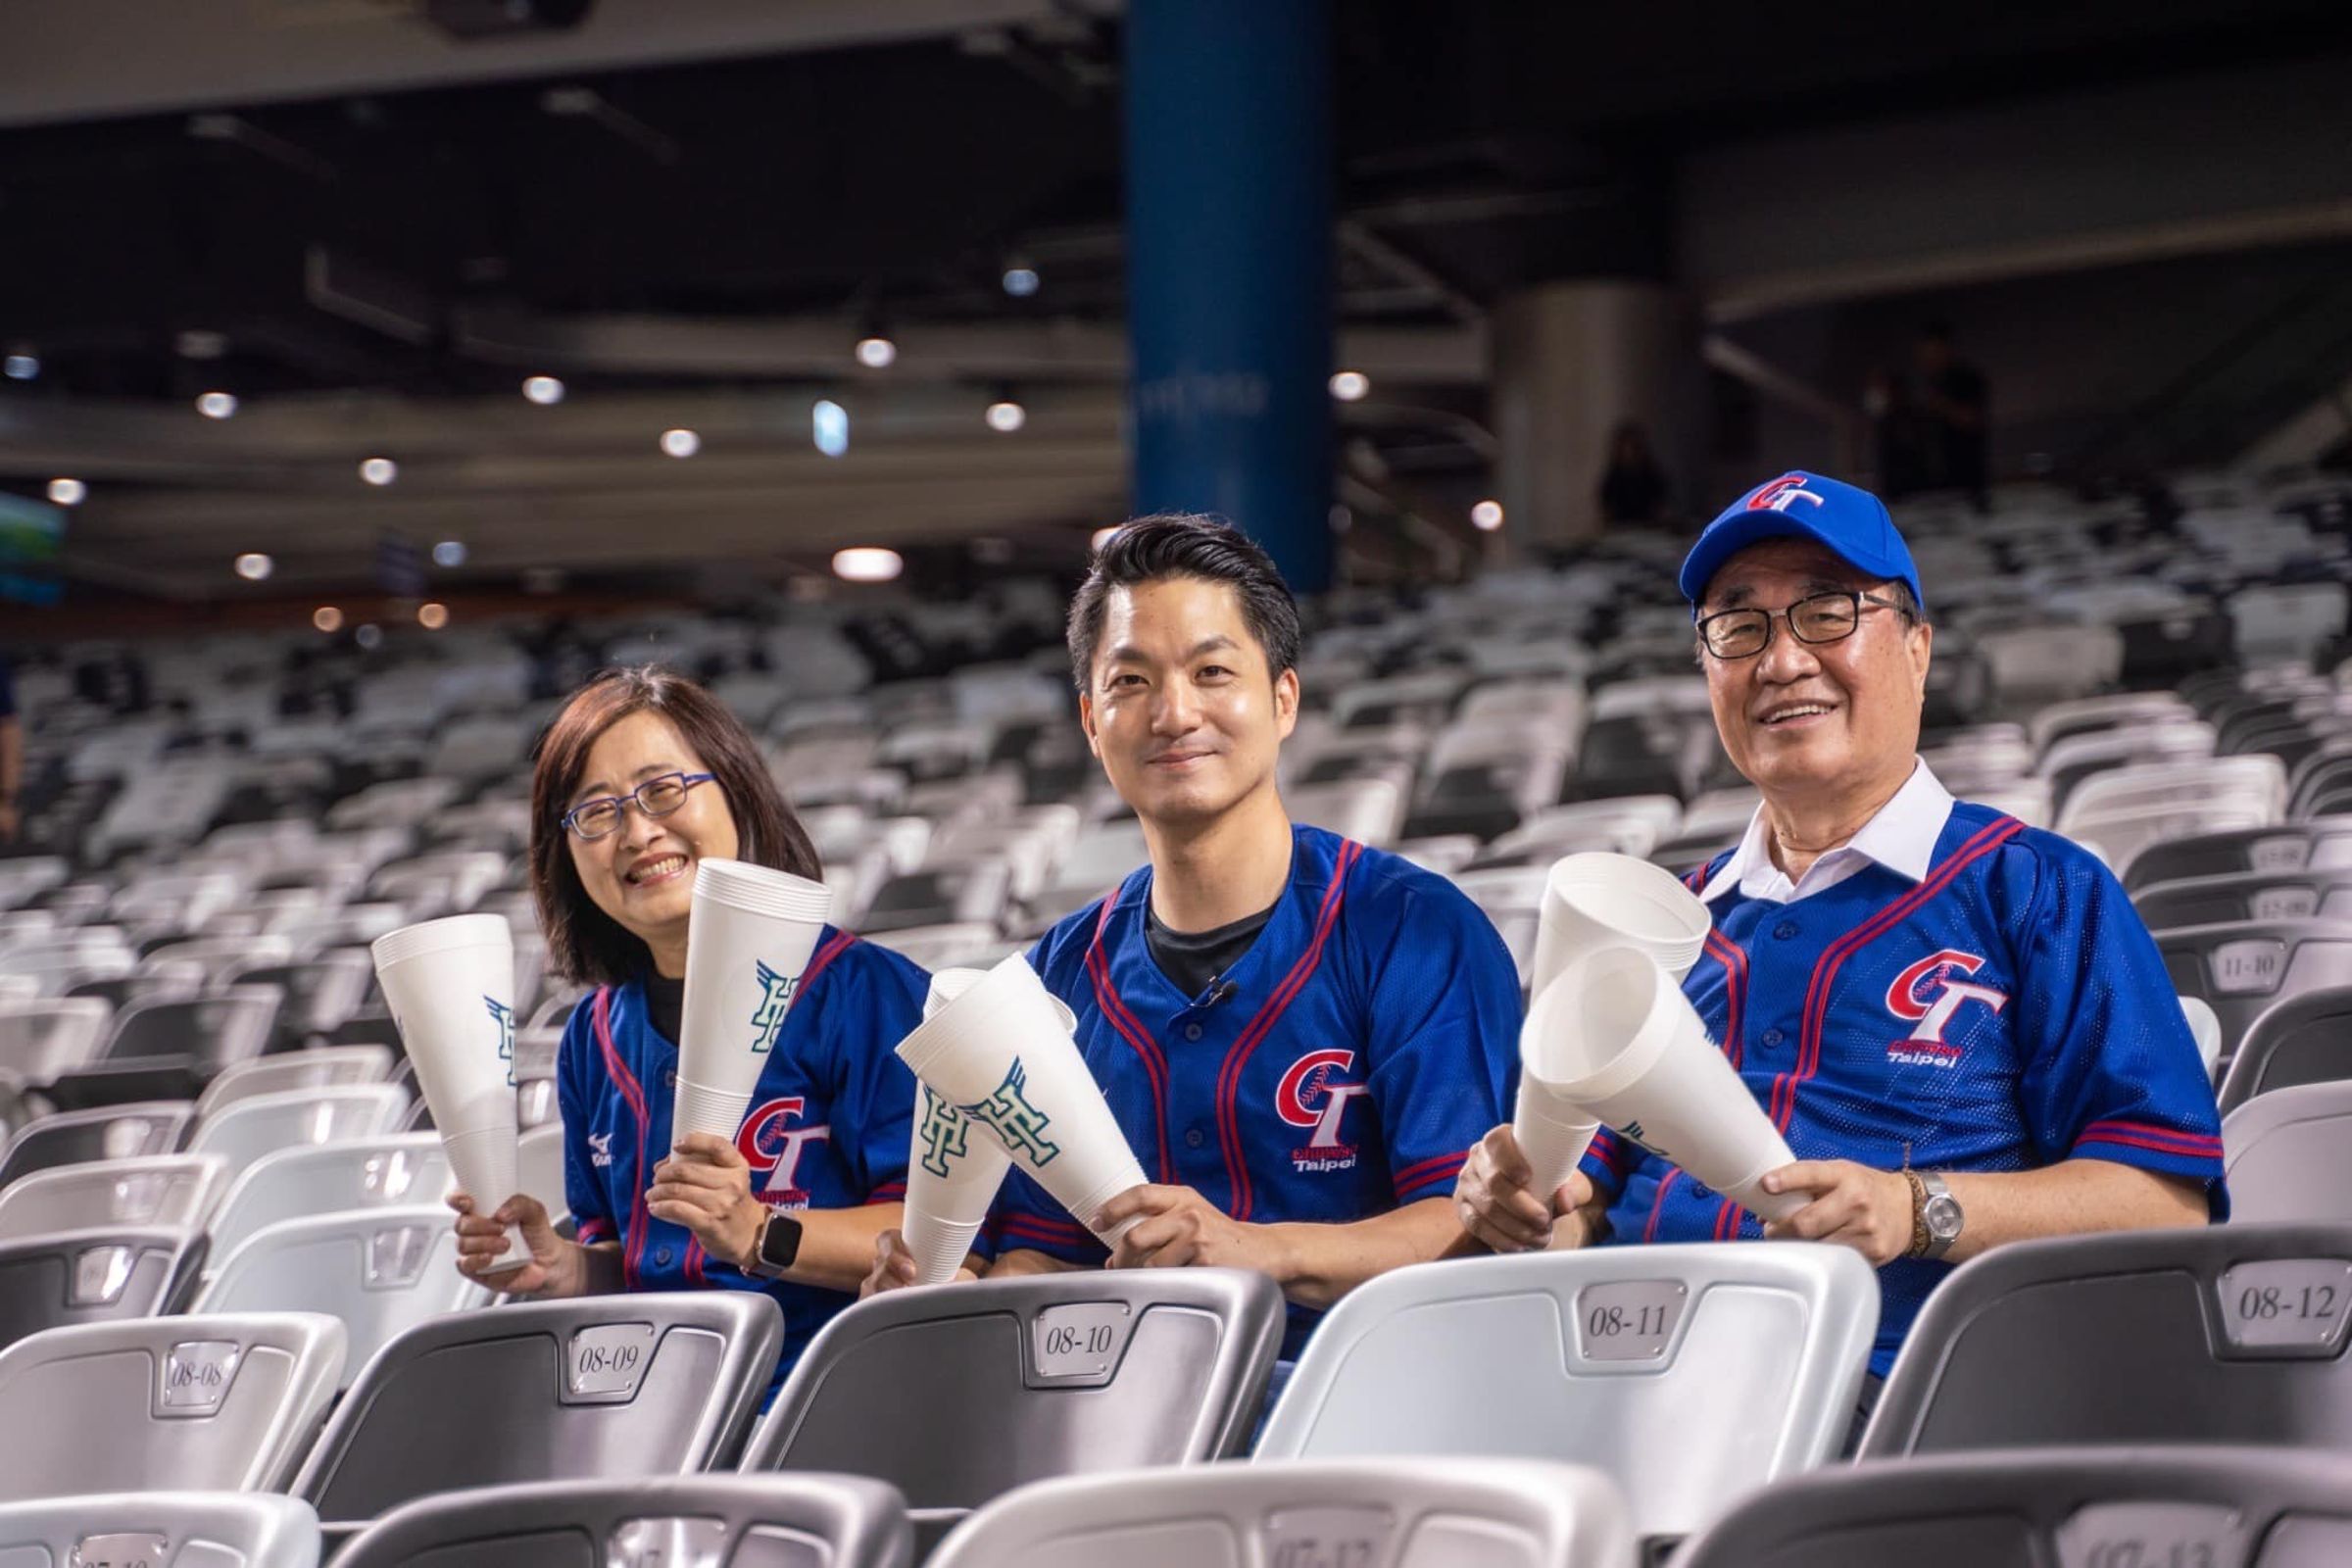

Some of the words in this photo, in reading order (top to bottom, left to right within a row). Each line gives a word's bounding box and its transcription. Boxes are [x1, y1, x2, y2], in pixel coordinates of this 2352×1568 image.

[2225, 956, 2275, 976] 11-10
[1887, 1052, 1959, 1069] Taipei
[1293, 1153, 1356, 1173] Taipei
[2239, 1285, 2336, 1321] 08-12
[1590, 1305, 1666, 1337] 08-11
[1047, 1325, 1112, 1354] 08-10
[579, 1346, 639, 1374] 08-09
[172, 1361, 222, 1387] 08-08
